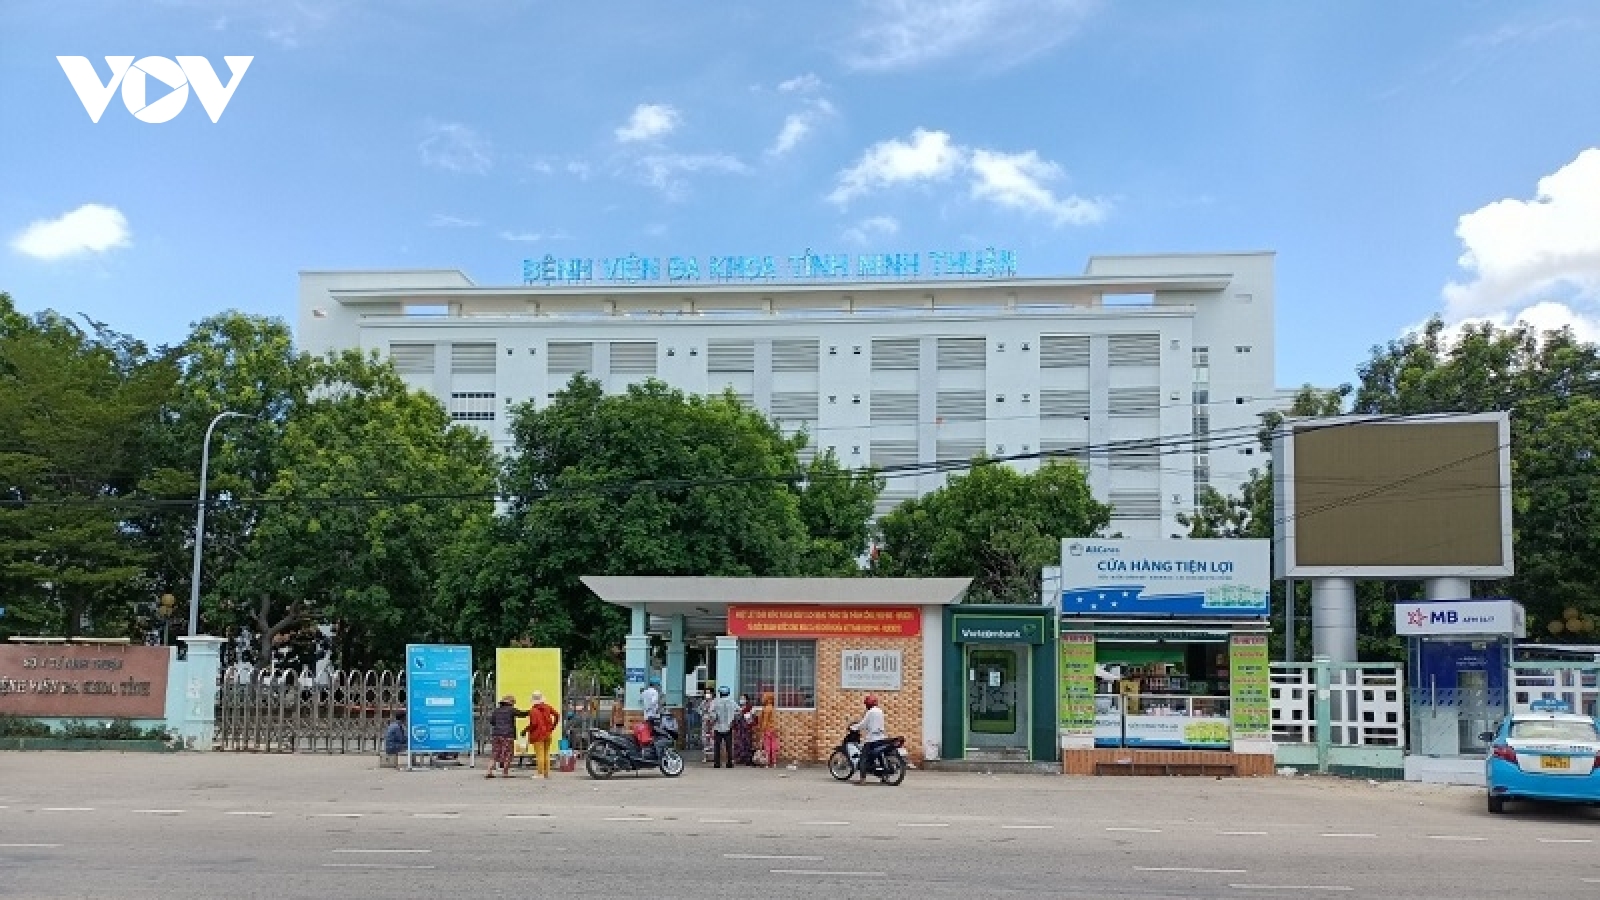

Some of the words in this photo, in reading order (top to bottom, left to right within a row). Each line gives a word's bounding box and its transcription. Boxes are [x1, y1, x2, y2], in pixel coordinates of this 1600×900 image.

[523, 254, 592, 285] BỆNH
[604, 252, 661, 283] VIỆN
[668, 256, 700, 278] ĐA
[710, 256, 775, 278] KHOA
[788, 248, 848, 277] TỈNH
[858, 253, 920, 277] NINH
[928, 247, 1016, 277] THUẬN
[1097, 557, 1127, 572] CỬA
[1131, 557, 1173, 573] HÀNG
[1176, 559, 1207, 575] TIỆN
[1211, 559, 1233, 575] LỢI
[1430, 610, 1458, 624] MB
[961, 628, 1021, 638] Vietcombank
[844, 652, 868, 671] CẤP
[873, 653, 897, 672] CỨU
